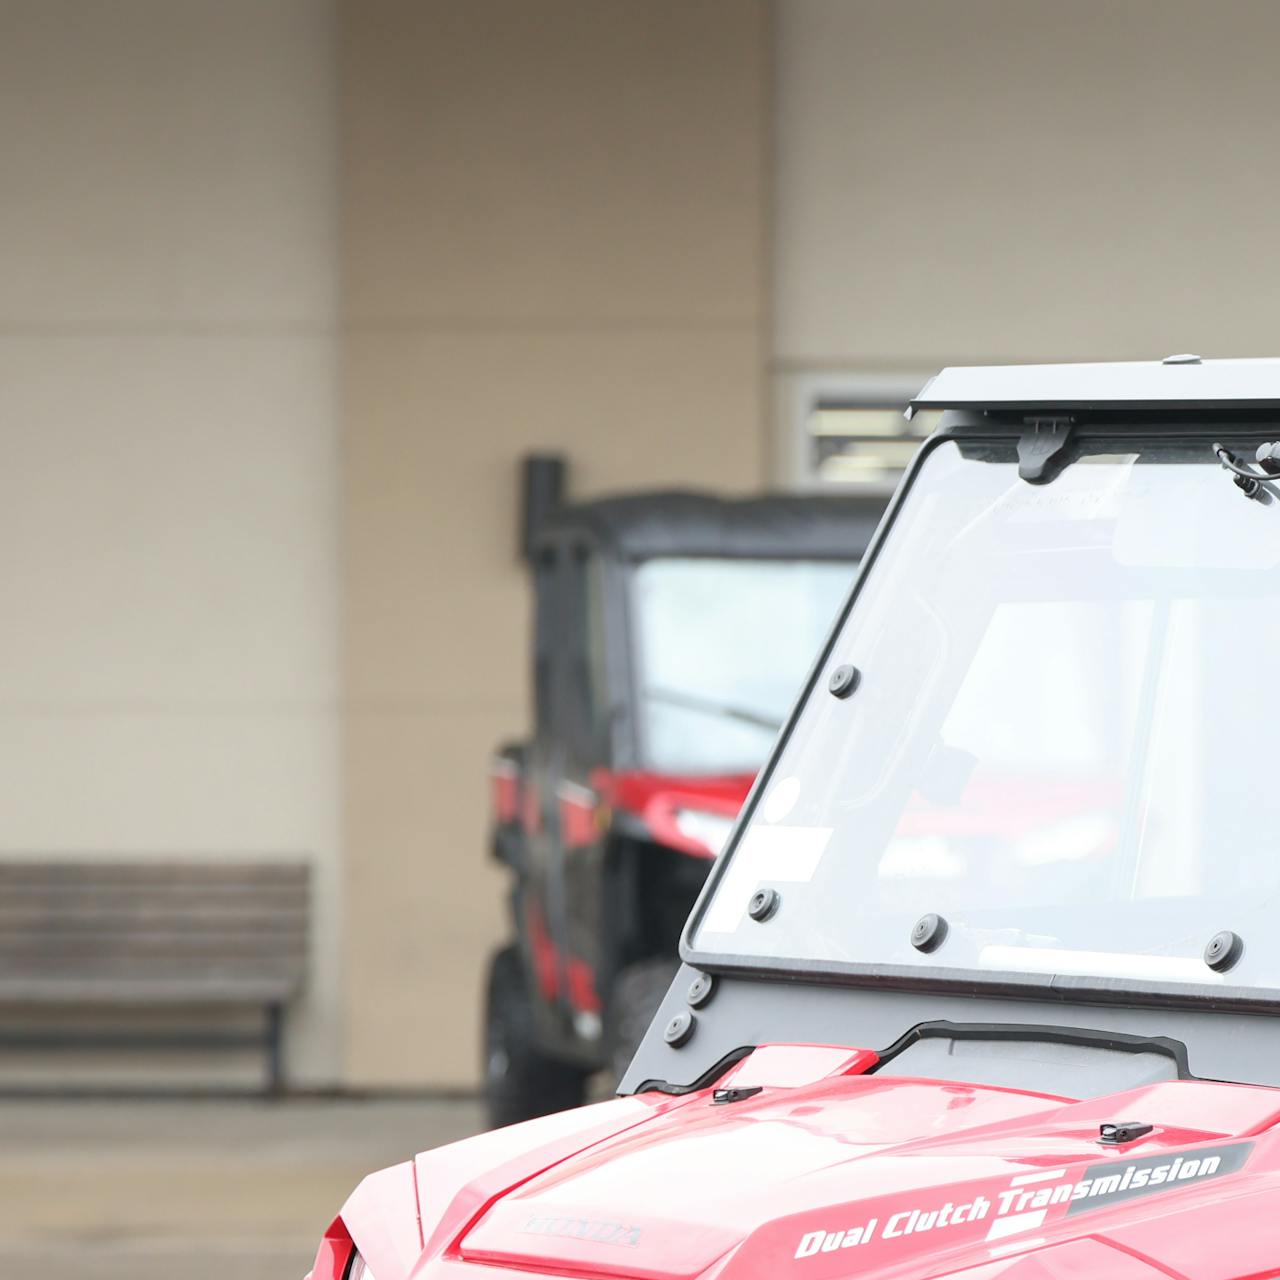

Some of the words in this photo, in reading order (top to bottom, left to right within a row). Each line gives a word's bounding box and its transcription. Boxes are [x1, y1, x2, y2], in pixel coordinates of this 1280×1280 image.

[794, 1217, 878, 1259] Dual
[882, 1196, 991, 1239] Clutch
[996, 1155, 1222, 1214] Transmission
